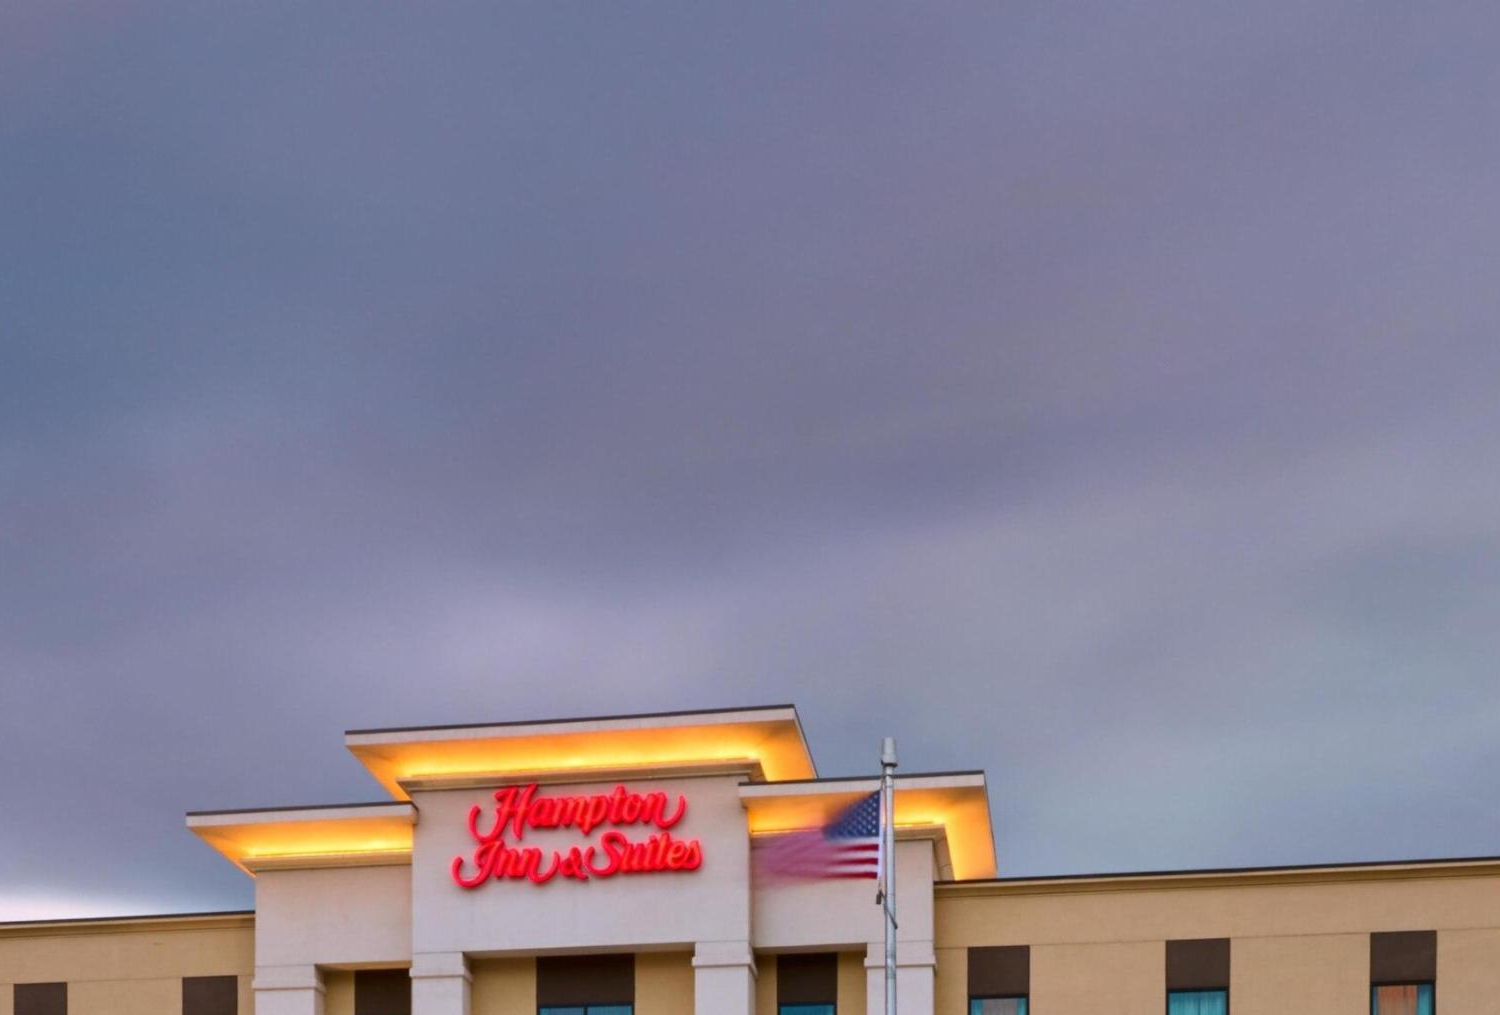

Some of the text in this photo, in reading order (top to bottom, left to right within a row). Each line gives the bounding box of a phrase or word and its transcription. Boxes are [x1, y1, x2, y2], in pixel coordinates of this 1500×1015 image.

[467, 783, 687, 843] Hampton
[451, 831, 703, 889] Inn & Suites
